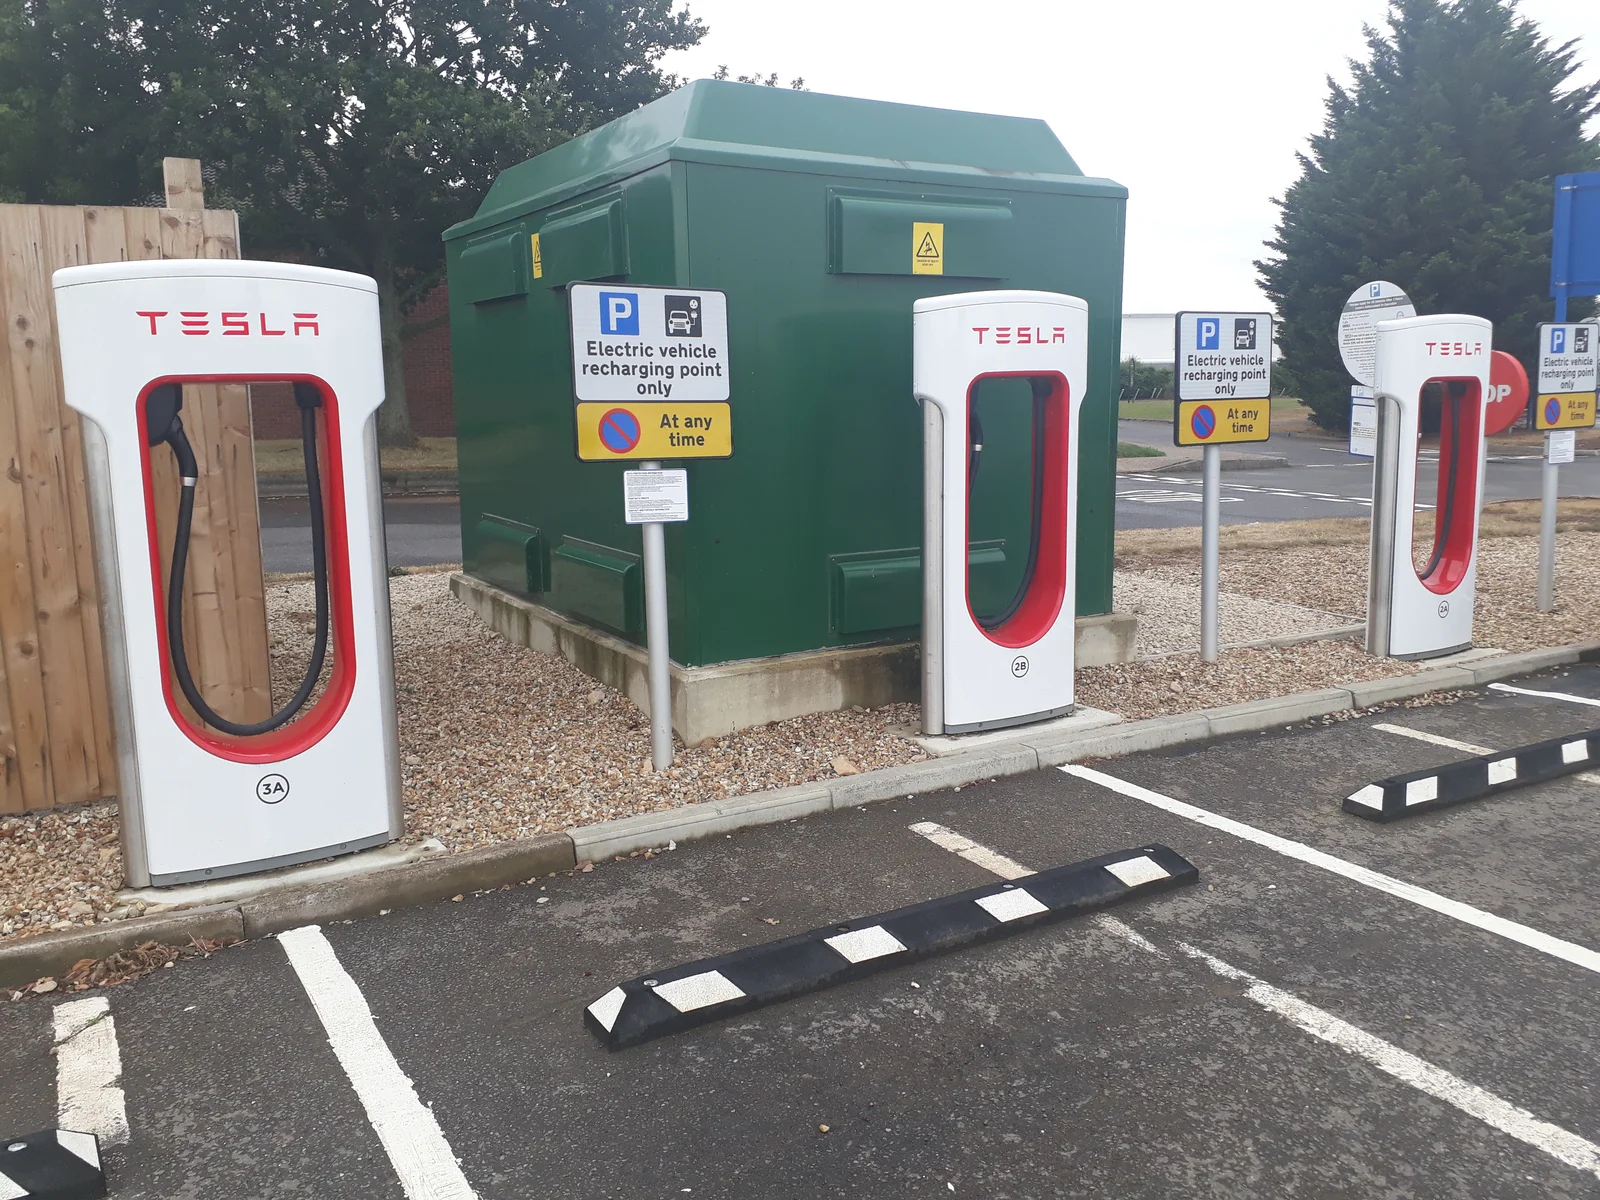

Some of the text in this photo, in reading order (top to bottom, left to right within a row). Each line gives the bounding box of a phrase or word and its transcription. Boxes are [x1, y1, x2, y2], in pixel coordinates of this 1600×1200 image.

[1372, 284, 1378, 296] P
[608, 297, 632, 331] P
[136, 311, 320, 336] TESLA
[972, 327, 1064, 344] TESLA
[1202, 322, 1216, 347] P
[1553, 330, 1563, 352] P
[586, 340, 717, 358] Electric vehicle
[1424, 342, 1482, 356] TESLA
[1187, 354, 1264, 366] Electric vehicle
[1544, 356, 1594, 366] Electric vehicle
[582, 360, 722, 380] recharging point
[1184, 368, 1266, 382] recharging point
[1542, 368, 1594, 380] recharging point
[636, 380, 672, 398] only
[1214, 382, 1236, 396] only
[1560, 380, 1574, 390] only
[1568, 400, 1589, 410] At any
[1226, 408, 1259, 421] At any
[1570, 411, 1585, 420] time
[660, 414, 712, 431] At any
[1232, 422, 1254, 434] time
[668, 432, 705, 447] time
[1014, 662, 1026, 671] 2B
[262, 782, 285, 795] 3A
